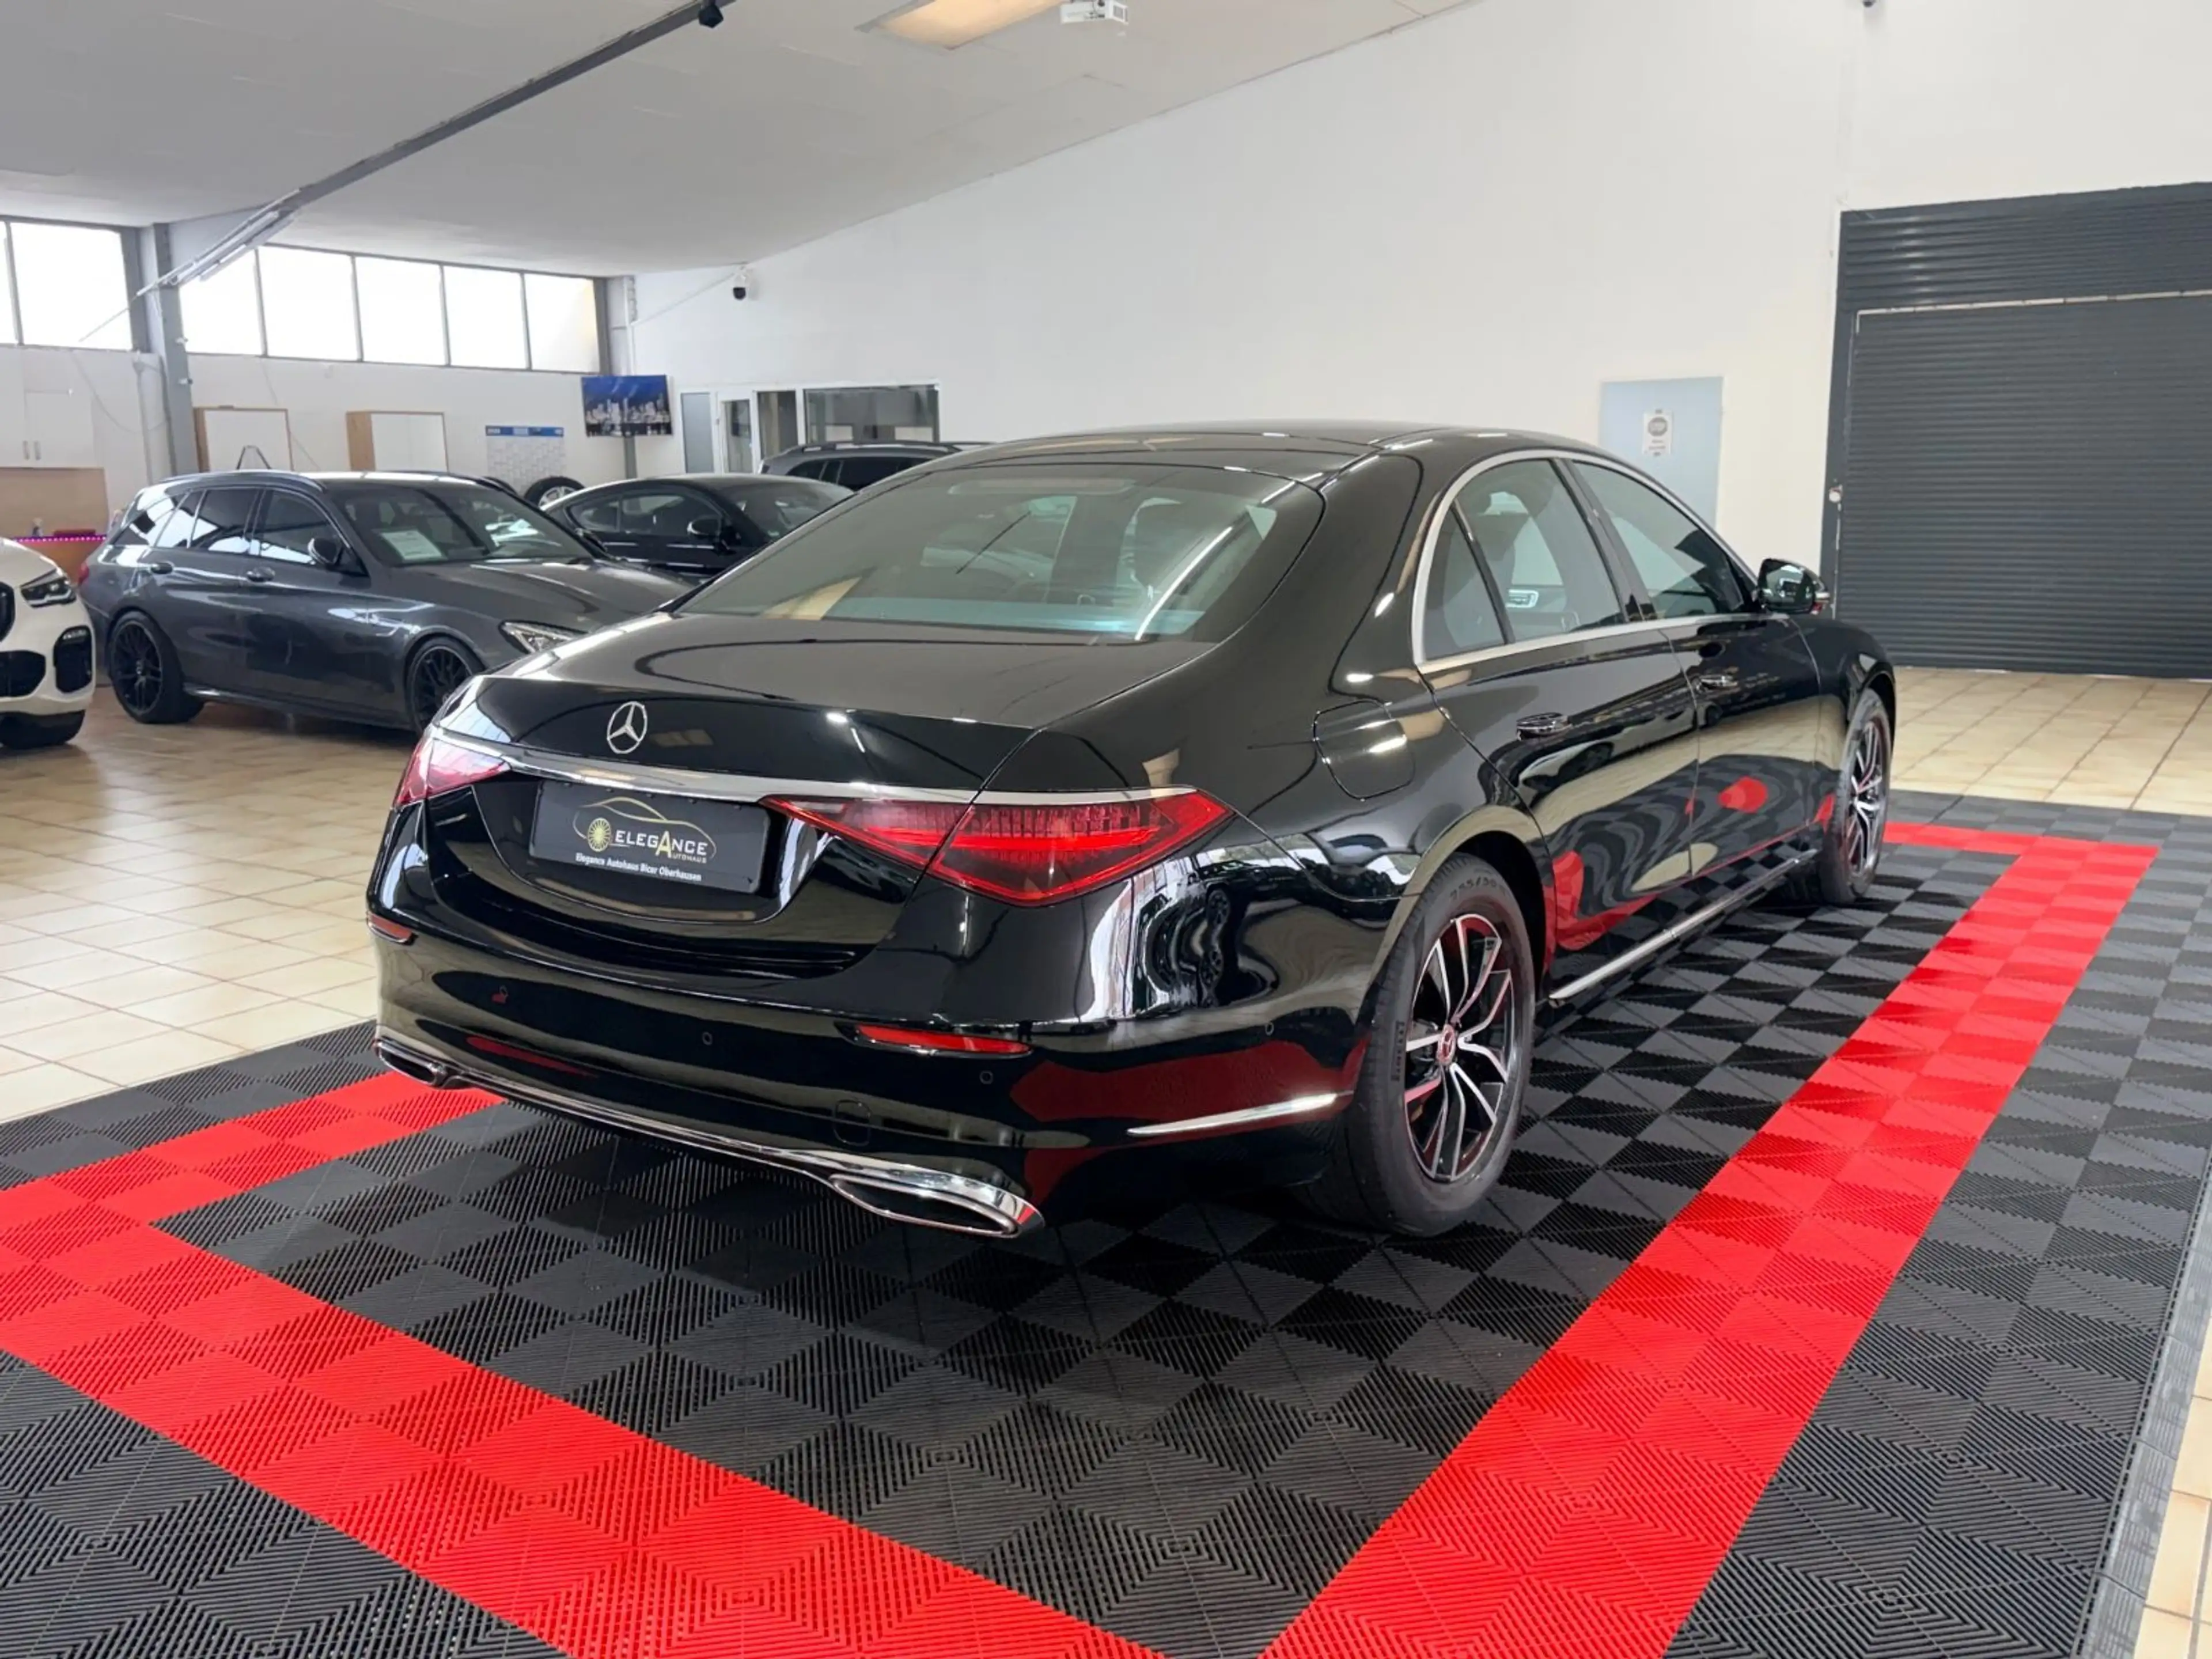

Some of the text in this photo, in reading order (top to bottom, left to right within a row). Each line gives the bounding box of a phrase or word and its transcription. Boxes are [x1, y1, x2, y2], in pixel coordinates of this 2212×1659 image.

[615, 830, 708, 858] ELEGANCE
[575, 852, 605, 866] Elegance
[607, 857, 639, 872] Autohaus
[659, 866, 702, 881] Oberhausen
